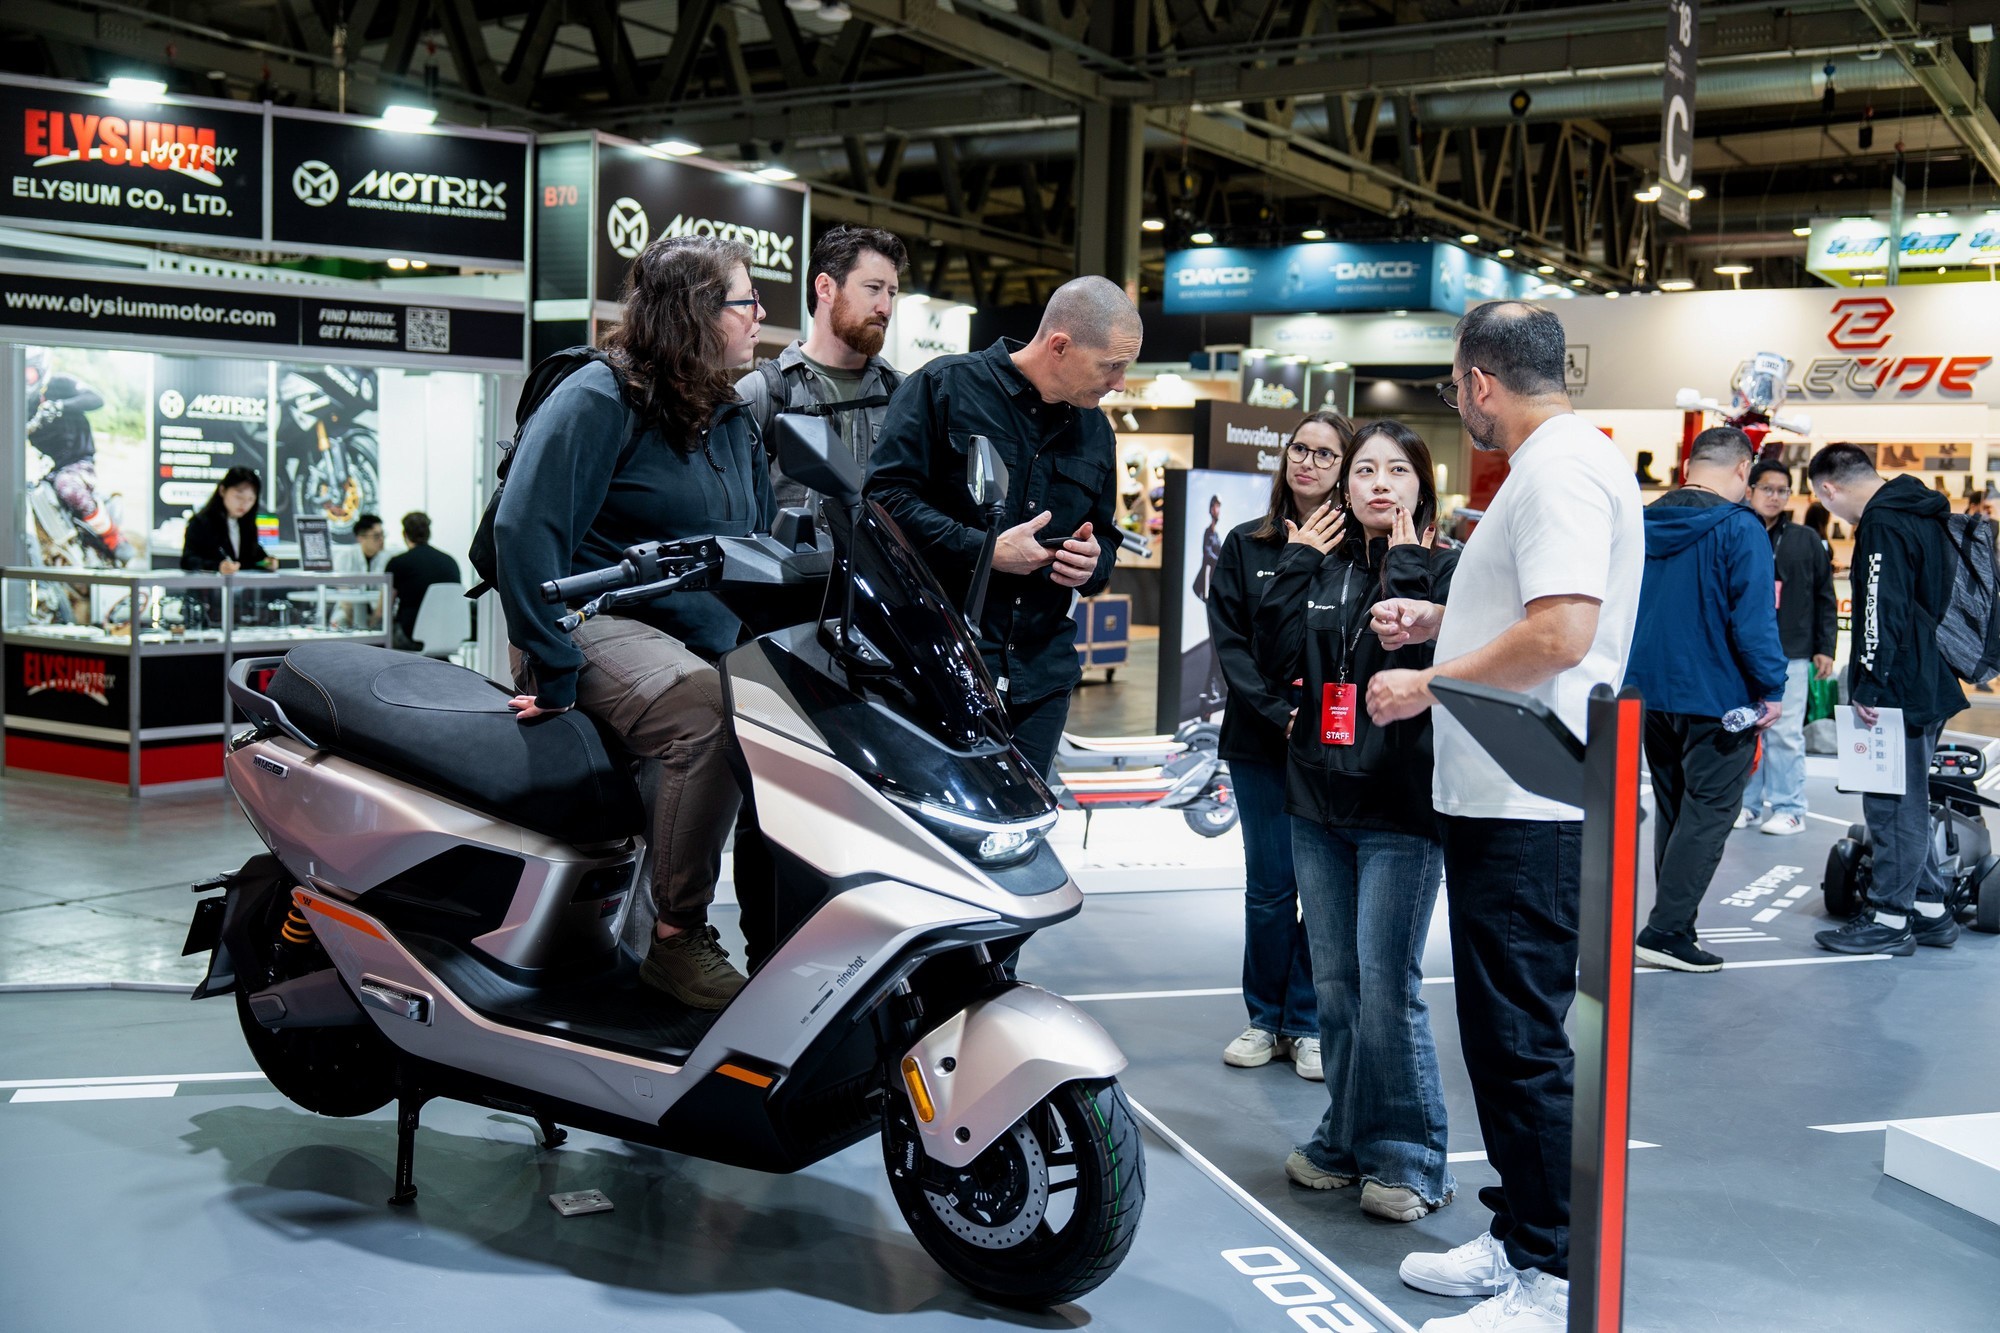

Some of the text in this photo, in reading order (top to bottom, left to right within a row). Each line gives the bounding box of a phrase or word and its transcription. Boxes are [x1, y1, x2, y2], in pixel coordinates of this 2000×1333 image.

[24, 109, 216, 173] ELYSIUM
[150, 138, 238, 167] MOTRIX
[1666, 95, 1689, 183] C
[12, 176, 233, 217] ELYSIUM CO., LTD.
[349, 169, 507, 209] MOTRIX
[543, 185, 577, 207] B70
[405, 202, 431, 214] PARTS
[433, 205, 450, 216] AND
[1179, 267, 1250, 286] DAYCO
[1335, 261, 1413, 280] DAYCO
[5, 291, 277, 327] www.elysiummotor.com
[319, 308, 397, 326] FIND MOTRIX.
[319, 325, 399, 343] GET PROMISE.
[1226, 422, 1280, 448] Innovation
[1326, 731, 1349, 740] STAFF
[836, 955, 867, 988] ninebot
[905, 1141, 915, 1170] ninebot
